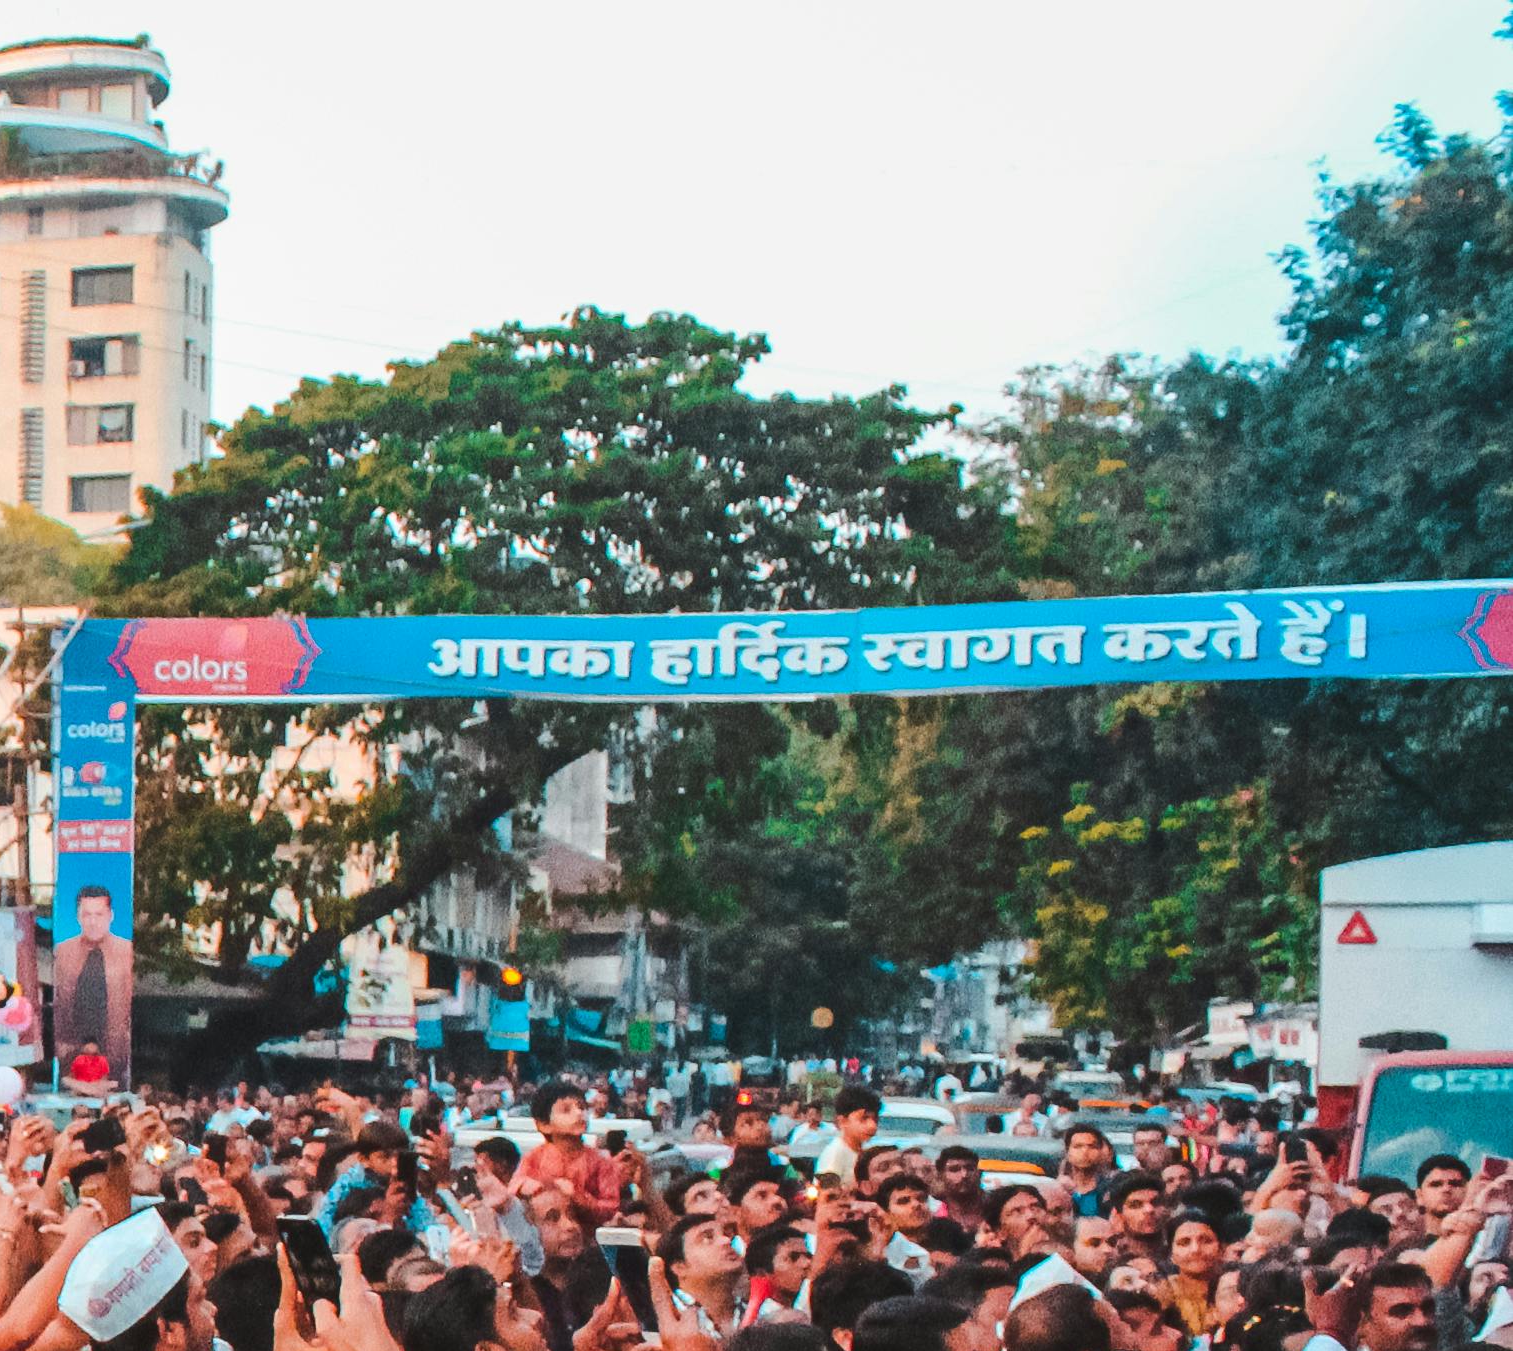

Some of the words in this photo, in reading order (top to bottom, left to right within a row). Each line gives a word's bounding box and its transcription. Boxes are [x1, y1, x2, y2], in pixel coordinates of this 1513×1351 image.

[427, 637, 636, 685] आपका
[650, 619, 849, 684] हार्दिक
[861, 624, 1086, 674] स्वागत
[1103, 601, 1263, 664] करते
[154, 653, 248, 683] colors
[67, 721, 126, 739] colors
